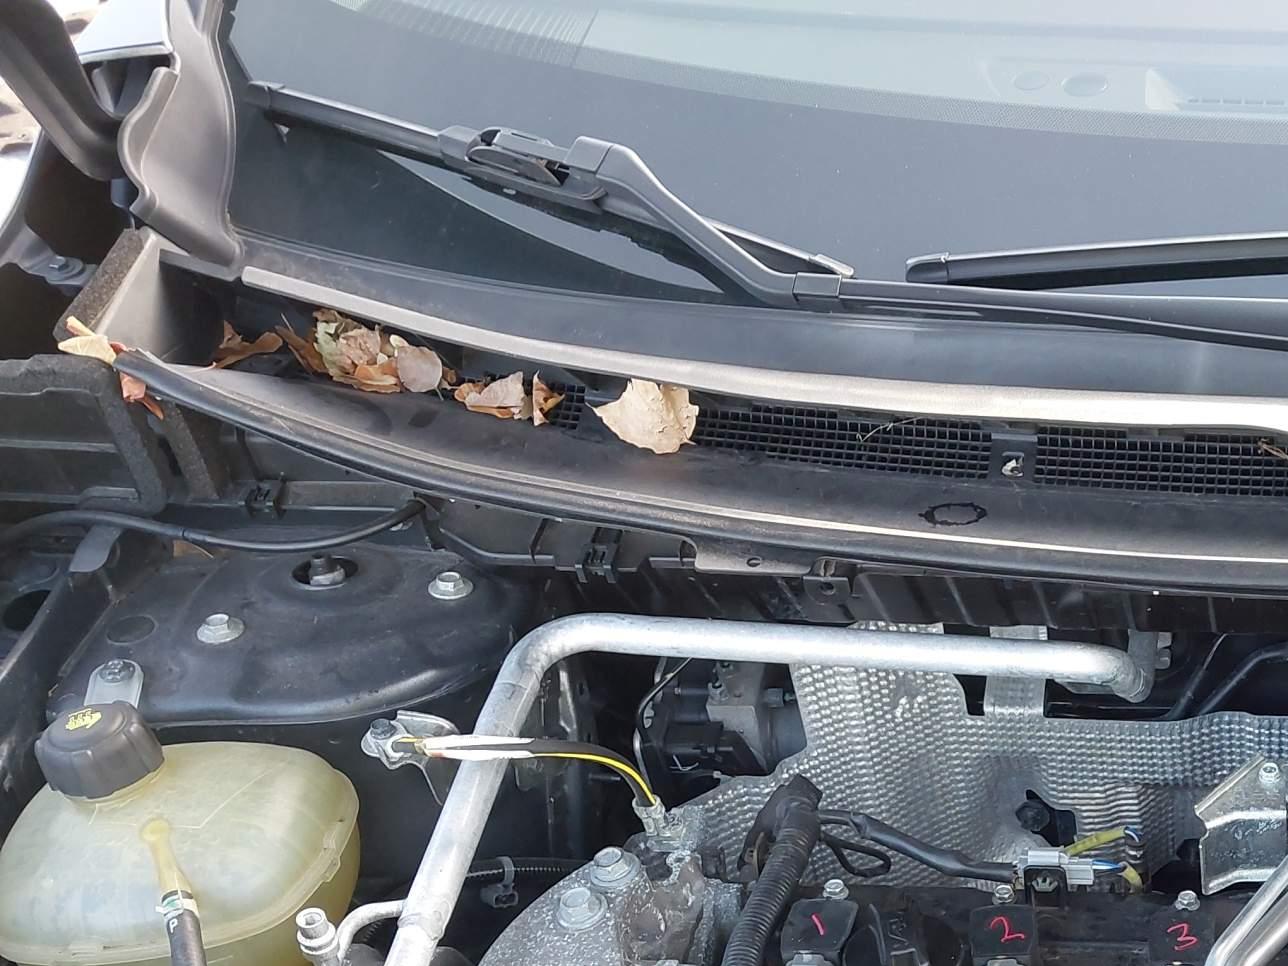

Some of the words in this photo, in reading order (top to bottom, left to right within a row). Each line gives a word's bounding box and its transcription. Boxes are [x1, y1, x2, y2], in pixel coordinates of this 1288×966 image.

[169, 918, 179, 934] P
[811, 912, 825, 936] 1
[989, 916, 1025, 942] 2
[1167, 922, 1199, 951] 3
